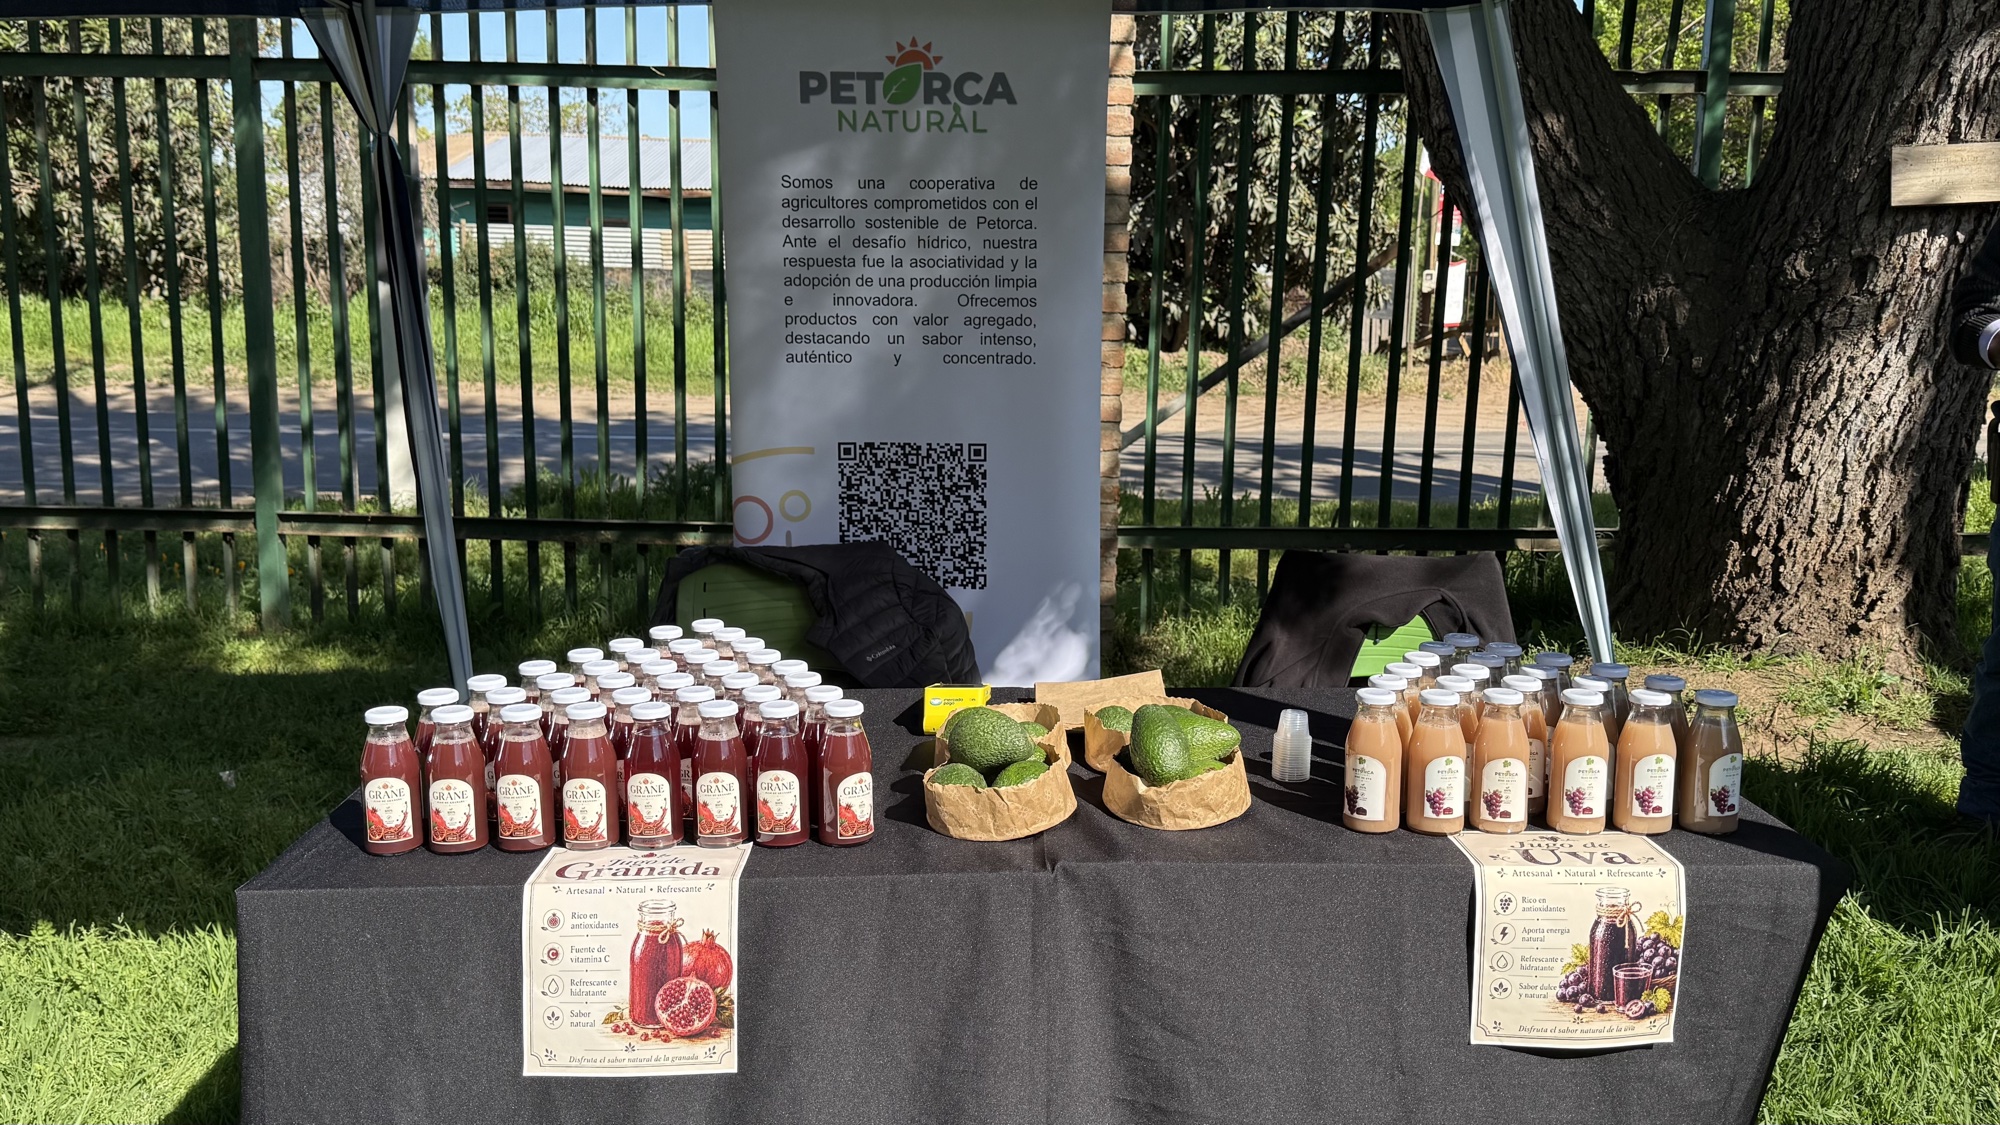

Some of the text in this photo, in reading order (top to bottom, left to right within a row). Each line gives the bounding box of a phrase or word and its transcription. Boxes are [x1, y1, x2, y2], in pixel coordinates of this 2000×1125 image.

[799, 62, 1017, 105] PETORCA
[837, 104, 988, 134] NATURAL
[781, 174, 1038, 193] Somos una cooperativa de
[781, 195, 1037, 213] agricultores comprometidos con el
[782, 214, 1037, 230] desarrollo sostenible de Petorca.
[782, 234, 1037, 251] Ante el desafío hídrico, nuestra
[783, 254, 1037, 272] respuesta fue la asociatividad y la
[784, 273, 1037, 291] adopción de una producción limpia
[784, 293, 1037, 308] e innovadora. Ofrecemos
[785, 312, 1036, 330] productos con valor agregado,
[785, 331, 1036, 348] destacando un sabor intenso,
[786, 350, 1036, 367] auténtico y concentrado.
[499, 784, 535, 796] GRANE
[630, 784, 665, 795] GRANE
[700, 782, 735, 794] GRANE
[760, 781, 795, 792] GRANE
[368, 788, 406, 800] GRANE
[432, 789, 469, 801] GRANE
[565, 789, 601, 800] GRANE
[1582, 841, 1611, 849] de
[1508, 848, 1641, 866] Uva
[555, 861, 721, 881] Granada
[1512, 869, 1653, 877] Artesanal Natural Refrescante
[566, 885, 702, 895] Artesanal Natural Refrescante
[1522, 896, 1537, 904] Rico
[570, 921, 619, 929] antioxidantes
[1521, 927, 1545, 935] Aporta
[570, 945, 606, 953] Fuente de
[570, 955, 610, 963] vitamina C
[1520, 955, 1559, 963] Refrescante
[1520, 963, 1554, 971] hidratante
[570, 978, 612, 987] Refrescante
[1519, 982, 1557, 991] Sabor dulce
[570, 988, 607, 996] hidratante
[570, 1009, 591, 1018] Sabor
[570, 1019, 596, 1027] natural
[1518, 1025, 1548, 1034] Disfruta
[1558, 1026, 1578, 1034] sabor
[1580, 1026, 1605, 1034] natural
[1606, 1025, 1614, 1033] de
[569, 1056, 598, 1065] Disfruta
[627, 1055, 653, 1063] natural
[663, 1054, 670, 1062] la
[670, 1053, 700, 1063] granada
